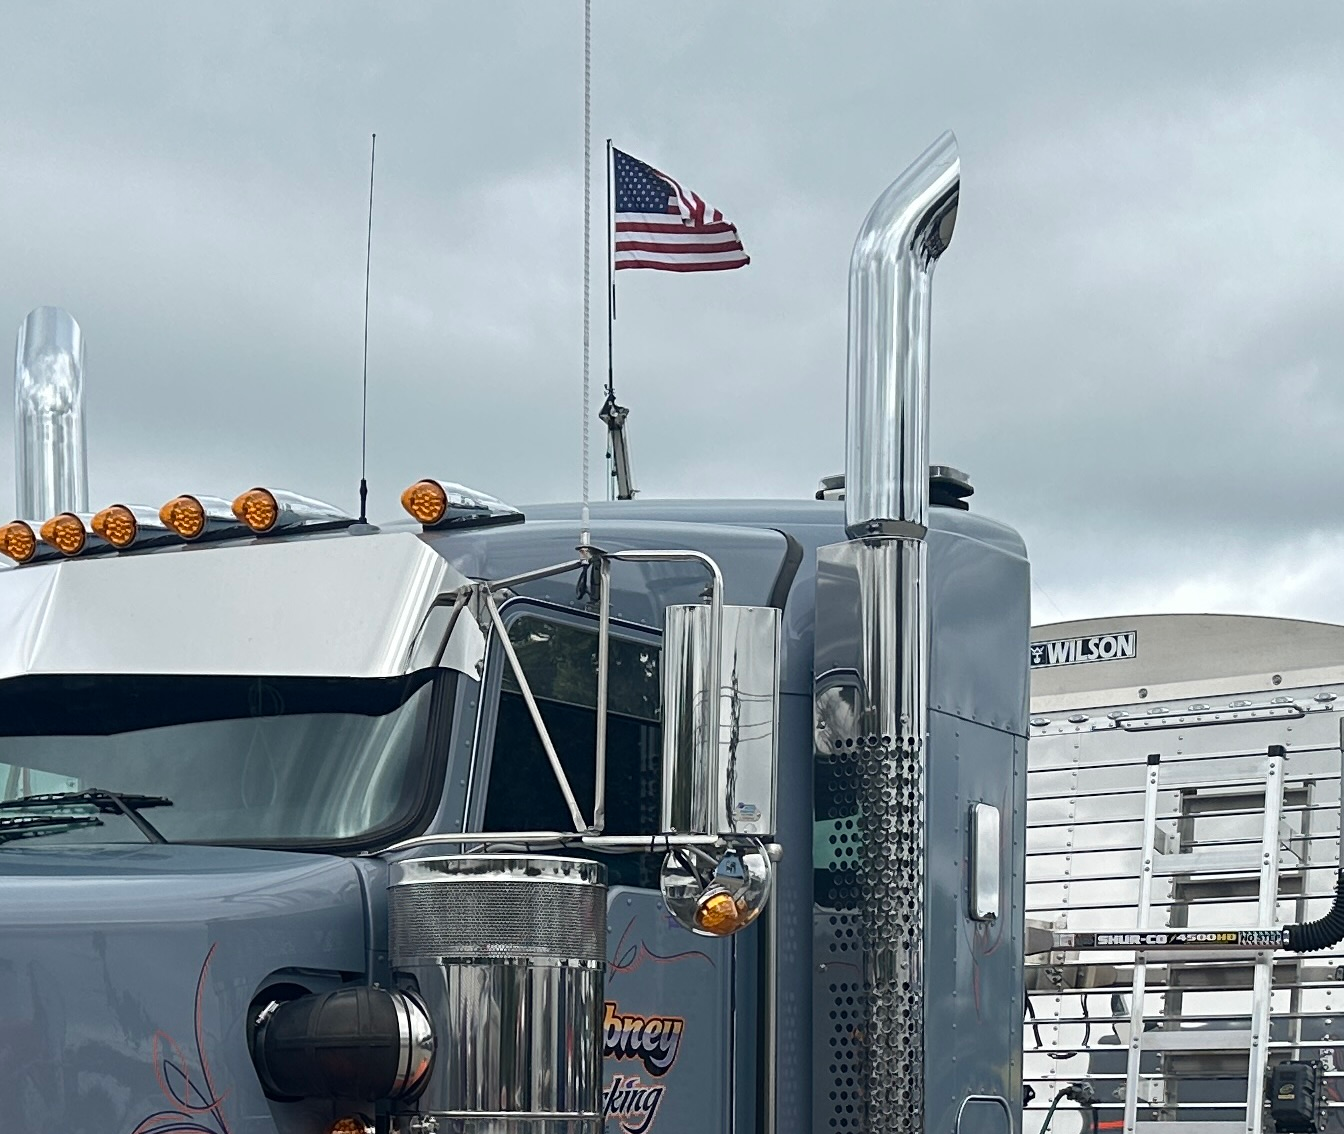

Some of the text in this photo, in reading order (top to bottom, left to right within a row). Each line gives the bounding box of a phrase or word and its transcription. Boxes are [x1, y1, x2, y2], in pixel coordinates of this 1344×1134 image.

[1047, 633, 1134, 664] WILSON
[1097, 934, 1168, 945] SHUR-CO
[603, 1001, 683, 1075] bney
